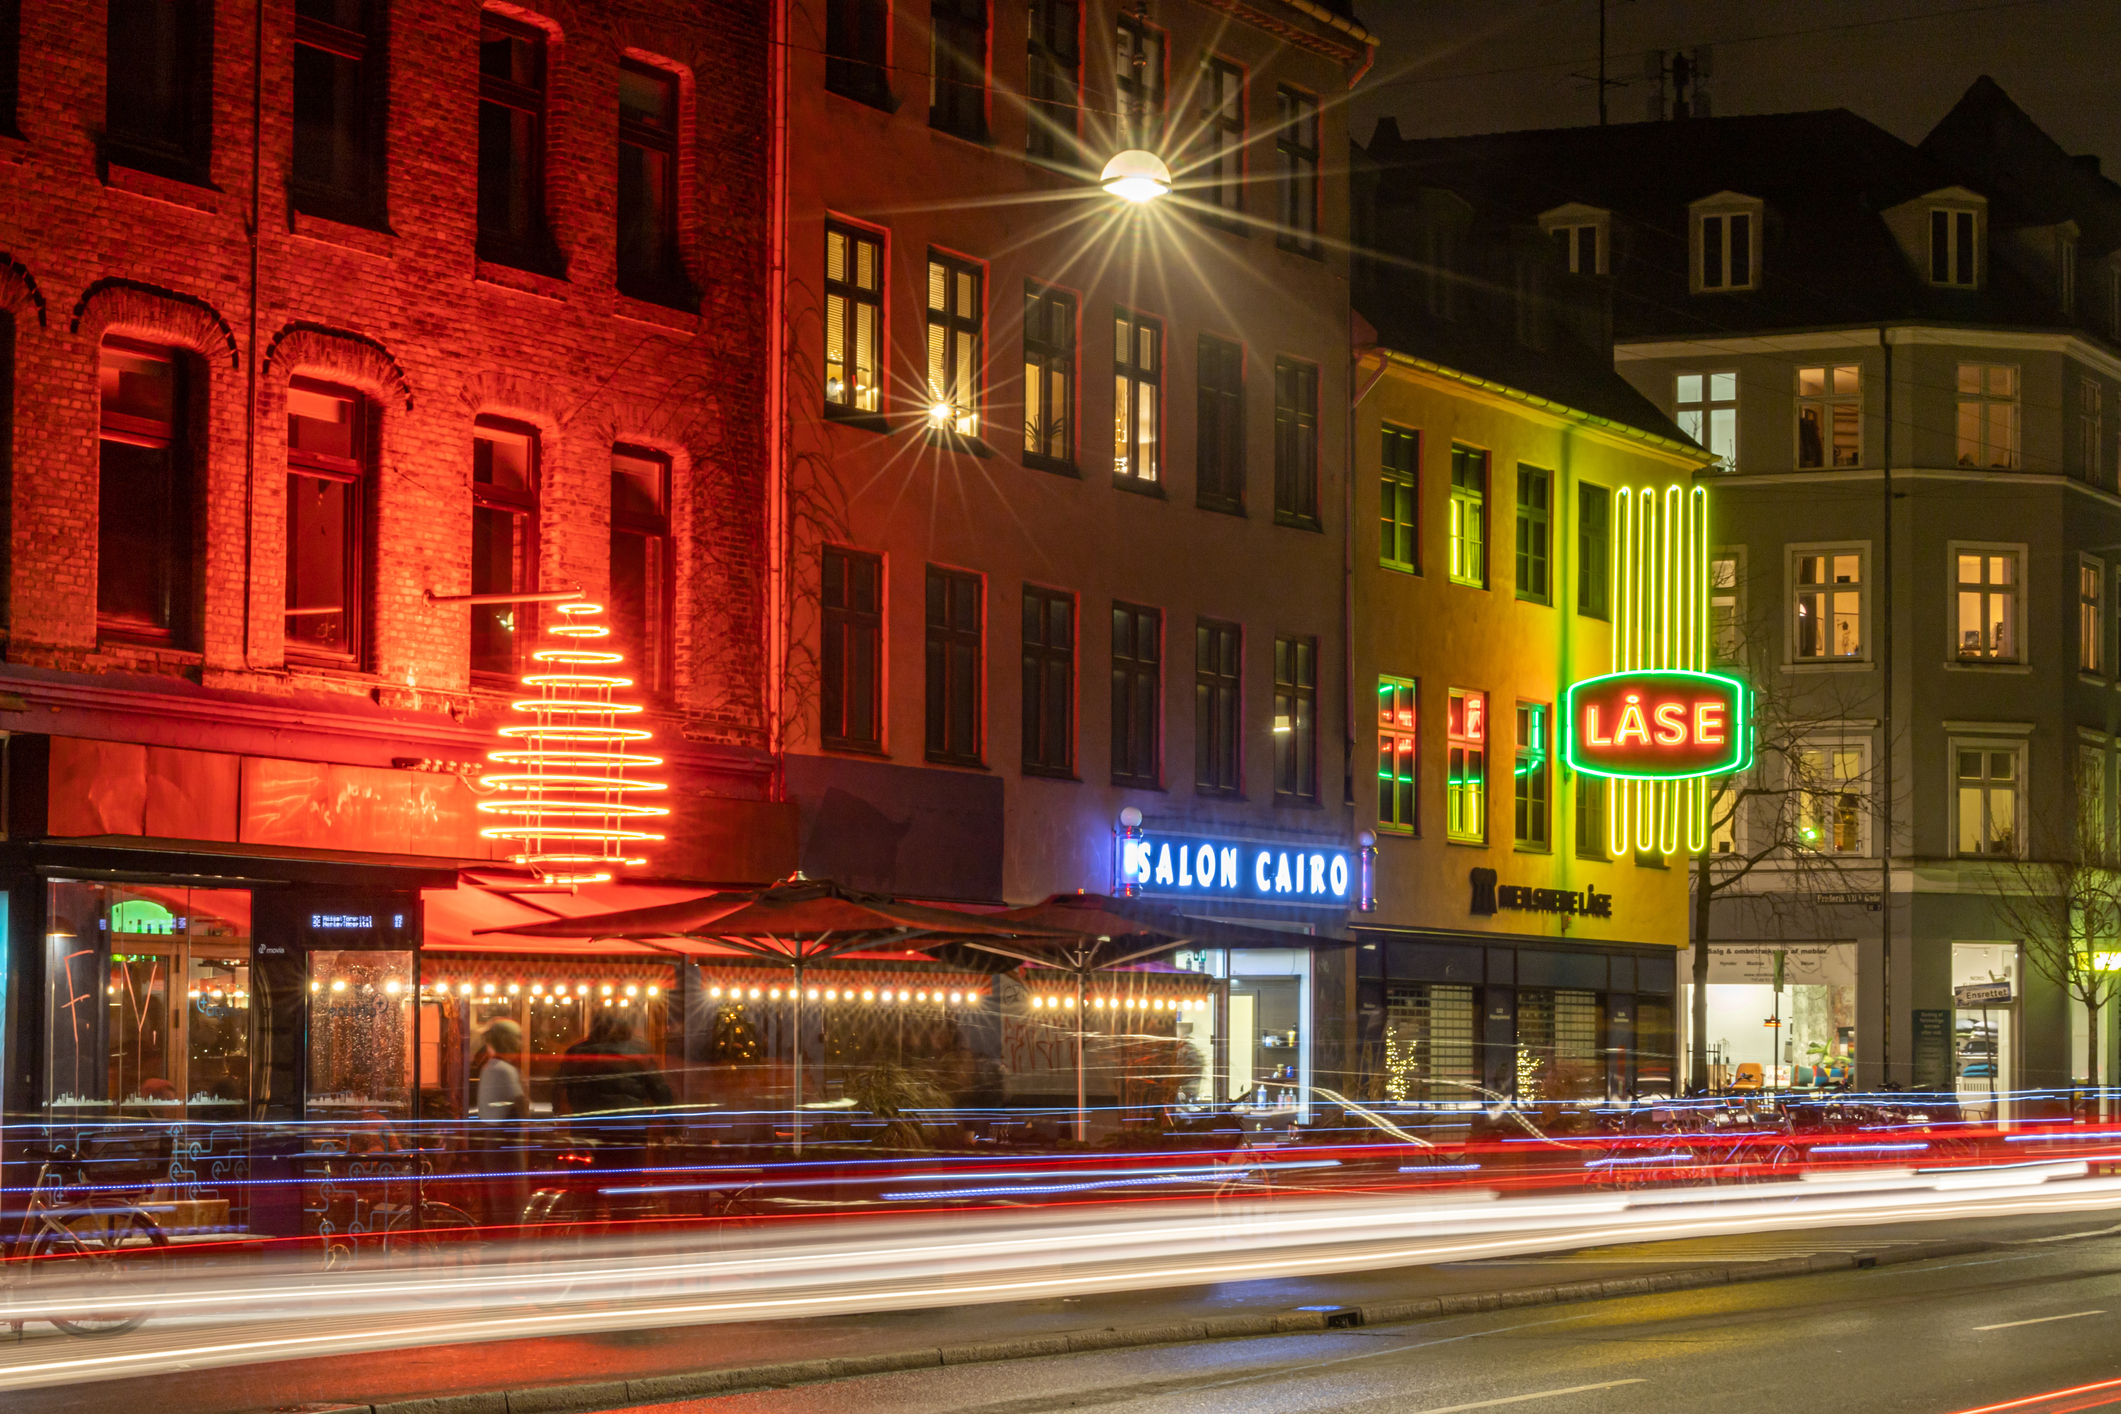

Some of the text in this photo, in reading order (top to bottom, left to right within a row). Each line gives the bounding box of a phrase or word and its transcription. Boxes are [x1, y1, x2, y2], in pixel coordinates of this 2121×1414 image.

[1586, 694, 1725, 747] LÅSE
[1137, 842, 1348, 896] SALON CAIRO
[1966, 989, 2007, 999] Ensrettet
